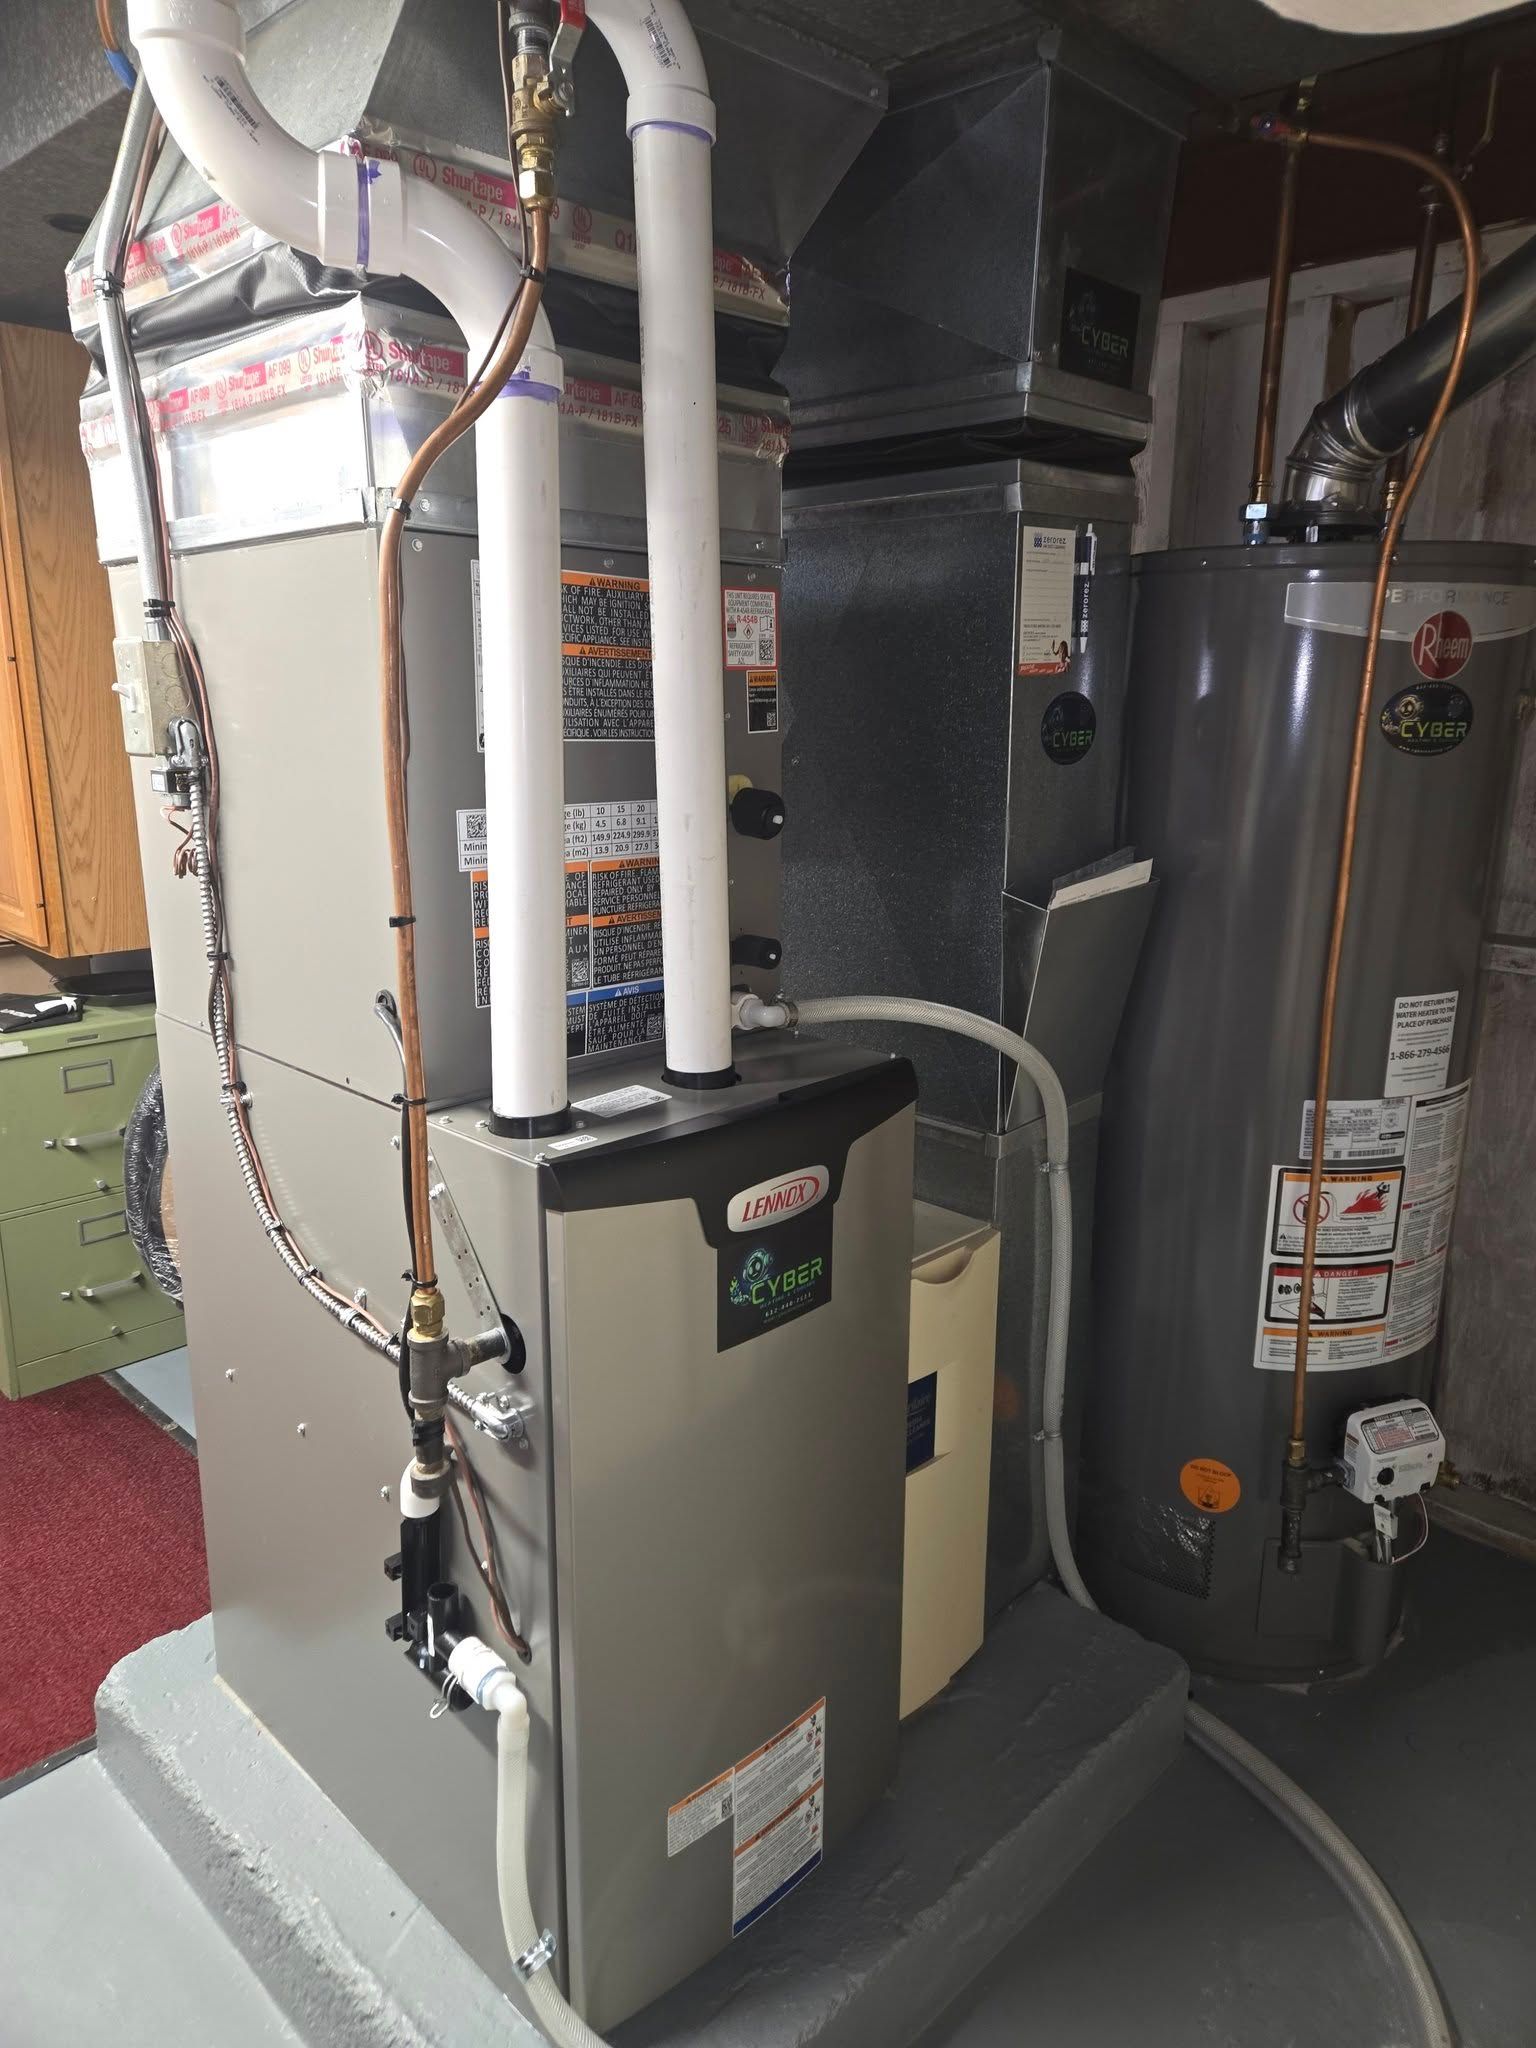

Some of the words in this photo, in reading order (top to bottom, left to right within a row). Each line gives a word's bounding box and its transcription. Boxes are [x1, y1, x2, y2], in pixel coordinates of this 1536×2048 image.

[443, 167, 504, 201] Shurtape
[1082, 325, 1129, 358] CYBER
[1043, 535, 1067, 545] zerorez
[597, 578, 640, 590] WARNING
[571, 586, 581, 595] OF
[606, 590, 645, 600] AUXILIARY
[582, 597, 596, 605] MAY
[599, 598, 607, 607] BE
[610, 600, 640, 610] IGNITION
[1082, 582, 1090, 618] zerorez
[579, 606, 593, 615] NOT
[598, 608, 606, 616] BE
[611, 610, 648, 620] INSTALLED
[599, 617, 621, 627] OTHER
[624, 619, 641, 628] THAN
[736, 615, 758, 624] R-454B
[563, 624, 584, 633] VICES
[586, 625, 608, 635] LISTED
[612, 628, 625, 636] FOR
[627, 629, 640, 637] USE
[620, 637, 630, 645] SEE
[1419, 612, 1470, 668] Rheem
[562, 667, 596, 677] XILIAIRES
[598, 669, 611, 678] QUI
[612, 670, 642, 679] PEUVENT
[618, 689, 634, 698] DANS
[636, 690, 643, 698] LE
[596, 699, 631, 708] L'EXCEPTION
[633, 700, 643, 708] DES
[629, 710, 645, 718] POUR
[602, 719, 620, 727] AVEC
[594, 729, 607, 737] VOIR
[608, 729, 618, 737] LES
[1401, 721, 1467, 737] CYBER
[1053, 730, 1093, 747] CYBER
[573, 809, 585, 819] (lb)
[597, 807, 605, 815] 10
[617, 805, 625, 813] 15
[637, 804, 645, 812] 20
[573, 822, 586, 831] (kg)
[596, 820, 606, 828] 4.5
[617, 818, 627, 826] 6.8
[573, 835, 587, 844] (ft2)
[592, 833, 610, 842] 149.9
[613, 831, 631, 839] 224.9
[633, 830, 650, 838] 299.9
[572, 848, 588, 857] (m2)
[594, 846, 609, 854] 13.9
[615, 844, 629, 852] 20.9
[610, 872, 619, 880] OF
[593, 878, 641, 889] REFRIGERANT
[567, 890, 586, 898] OCAL
[593, 888, 624, 898] REPAIRED
[593, 897, 620, 907] SERVICE
[594, 904, 625, 915] PUNCTURE
[594, 928, 616, 937] RISQUE
[594, 948, 604, 956] UN
[606, 943, 644, 954] PERSONNEL
[621, 953, 636, 961] PEUT
[594, 964, 620, 974] PRODUIT
[624, 962, 632, 970] NE
[633, 960, 644, 968] PAS
[594, 976, 601, 984] LE
[604, 973, 620, 982] TUBE
[623, 986, 639, 996] AVIS
[569, 1006, 585, 1016] STEM
[590, 1012, 597, 1020] DE
[603, 1007, 625, 1016] FUITE
[1418, 1009, 1439, 1017] HEATER
[589, 1015, 626, 1027] L'APPAREIL
[632, 1011, 646, 1020] DOIT
[1426, 1016, 1452, 1025] PURCHASE
[589, 1034, 607, 1046] SAUF
[612, 1030, 633, 1040] POUR
[636, 1028, 646, 1036] LA
[742, 1182, 807, 1222] LENNOX
[751, 1256, 823, 1305] CYBER
[1318, 1328, 1352, 1337] WARNING
